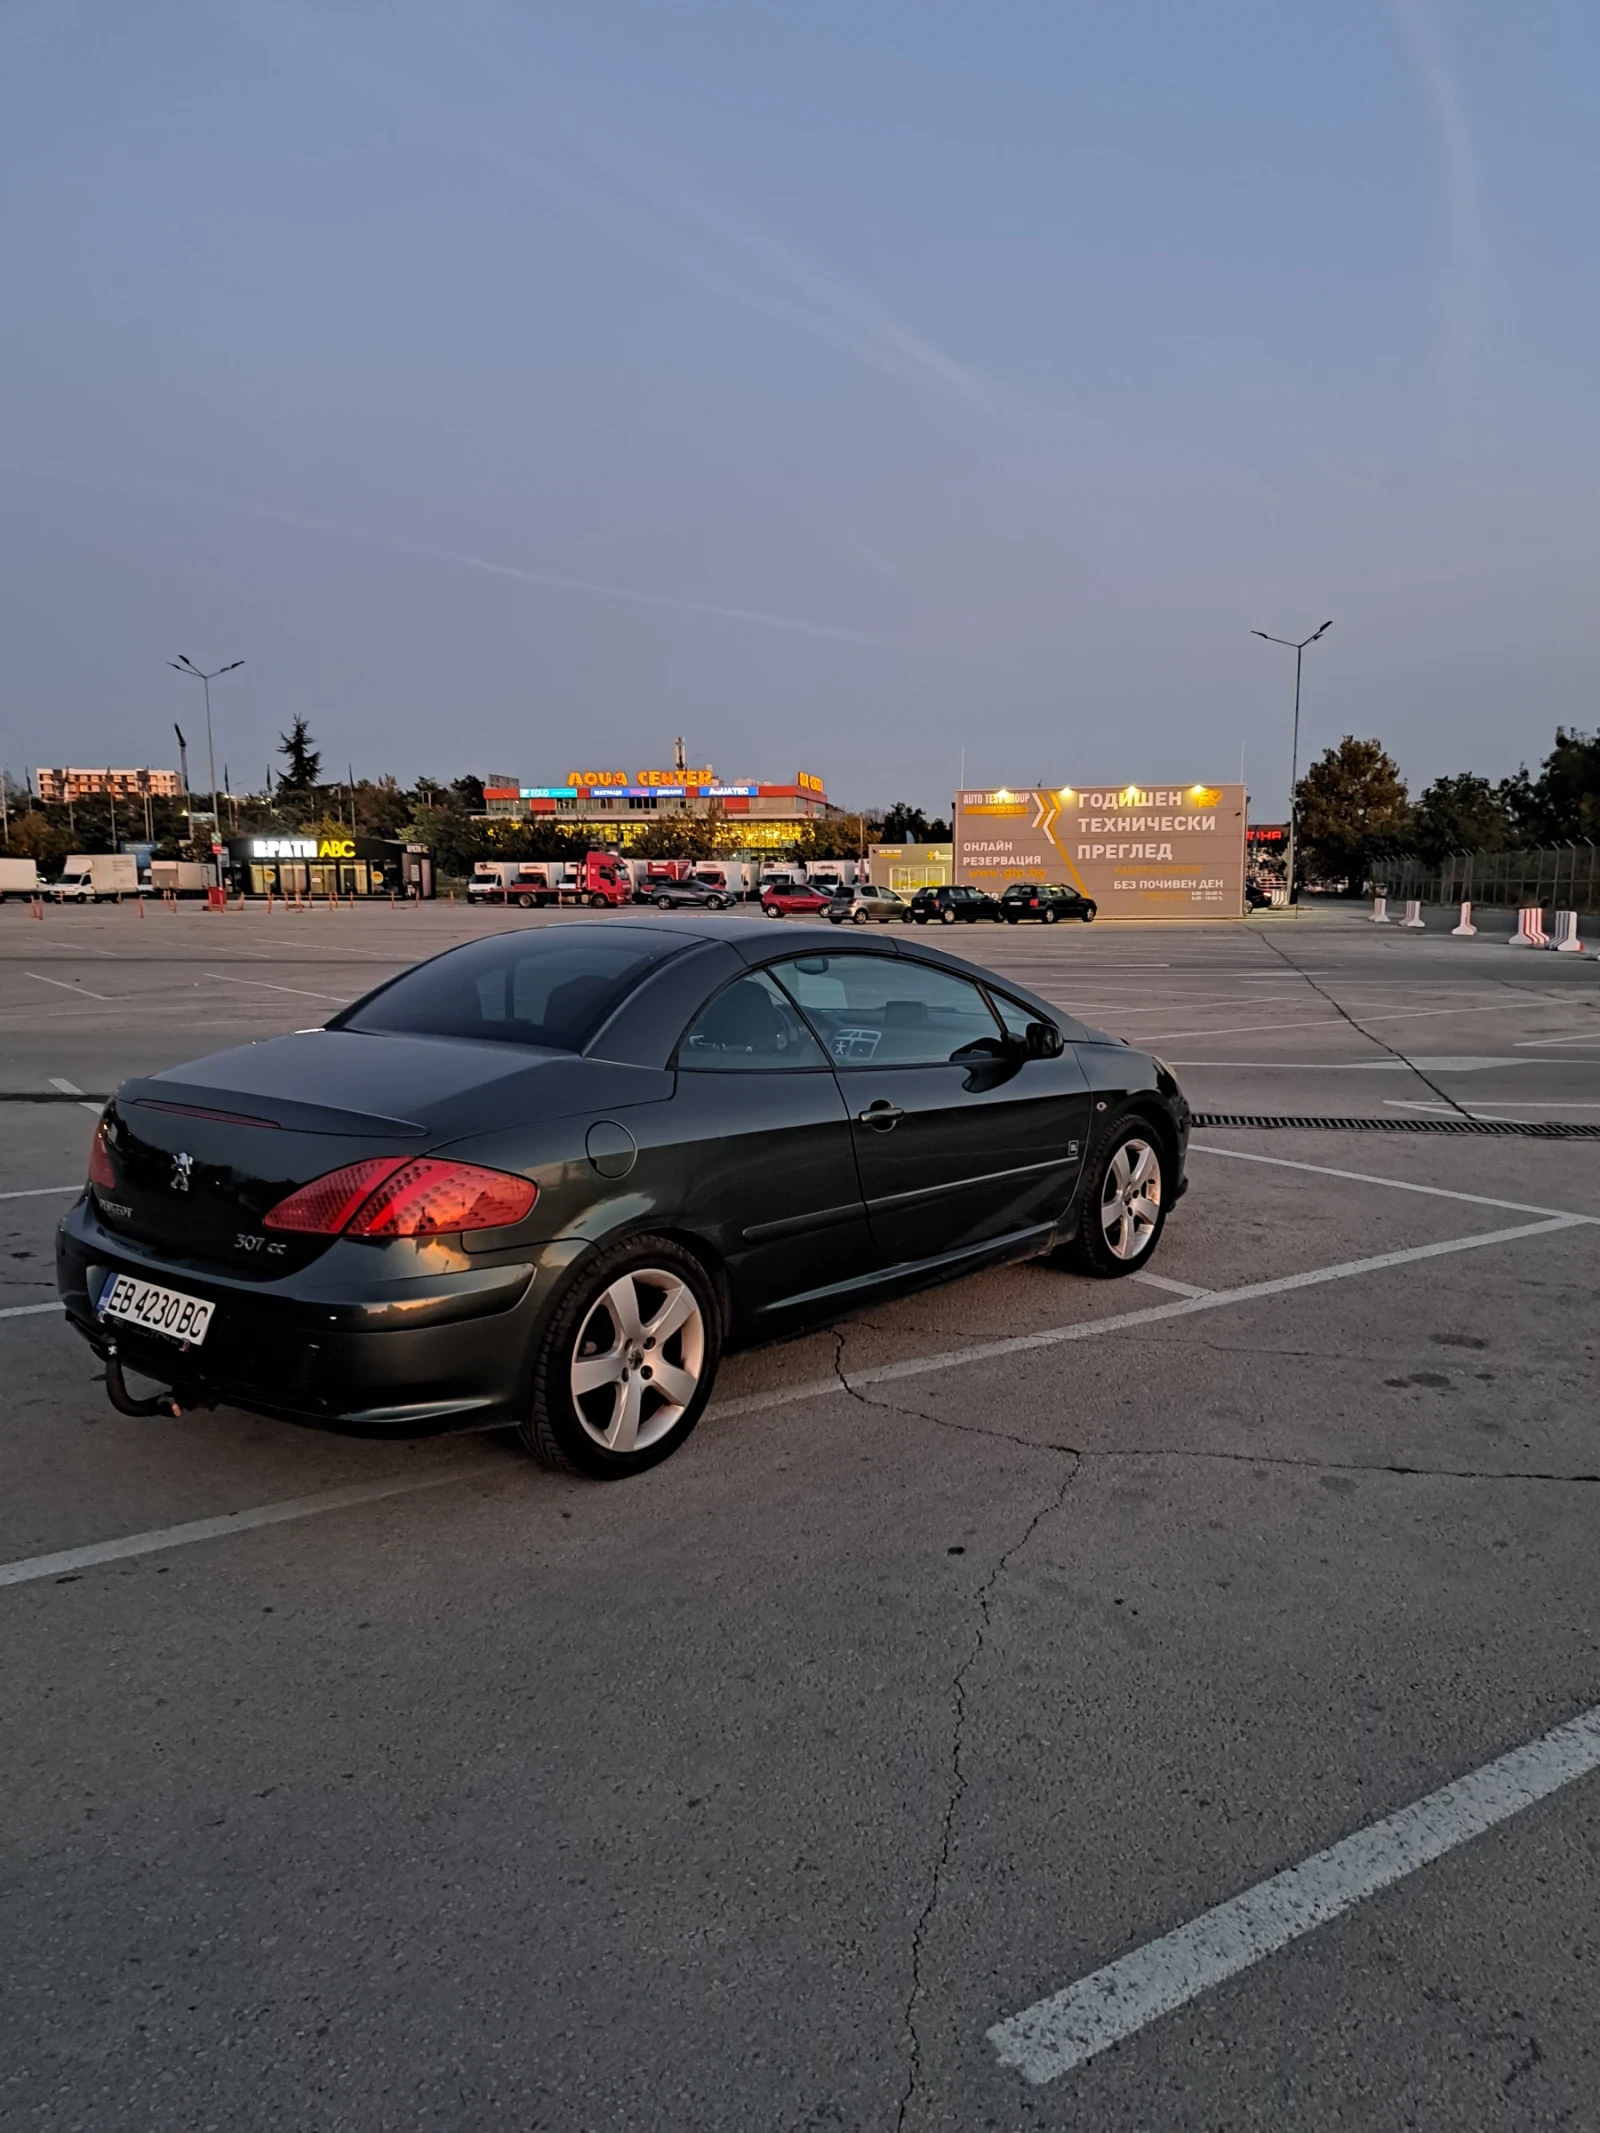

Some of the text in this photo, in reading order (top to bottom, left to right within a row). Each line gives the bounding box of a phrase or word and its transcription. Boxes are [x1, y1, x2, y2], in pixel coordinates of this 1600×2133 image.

[567, 769, 713, 787] AQUA CENTER
[963, 794, 983, 804] AUTO
[1077, 790, 1182, 810] ГОДИШЕН
[1077, 815, 1216, 833] ТЕХНИЧЕСКИ
[319, 840, 356, 858] ABC
[963, 840, 1013, 852] ОНЛАЙН
[1077, 843, 1173, 861] ПРЕГЛЕД
[962, 855, 1042, 867] РЕЗЕРВАЦИЯ
[1113, 879, 1224, 890] БЕЗ ПОЧИВЕН ДЕН
[233, 1233, 266, 1252] 307
[108, 1280, 209, 1338] EB 4230 BC
